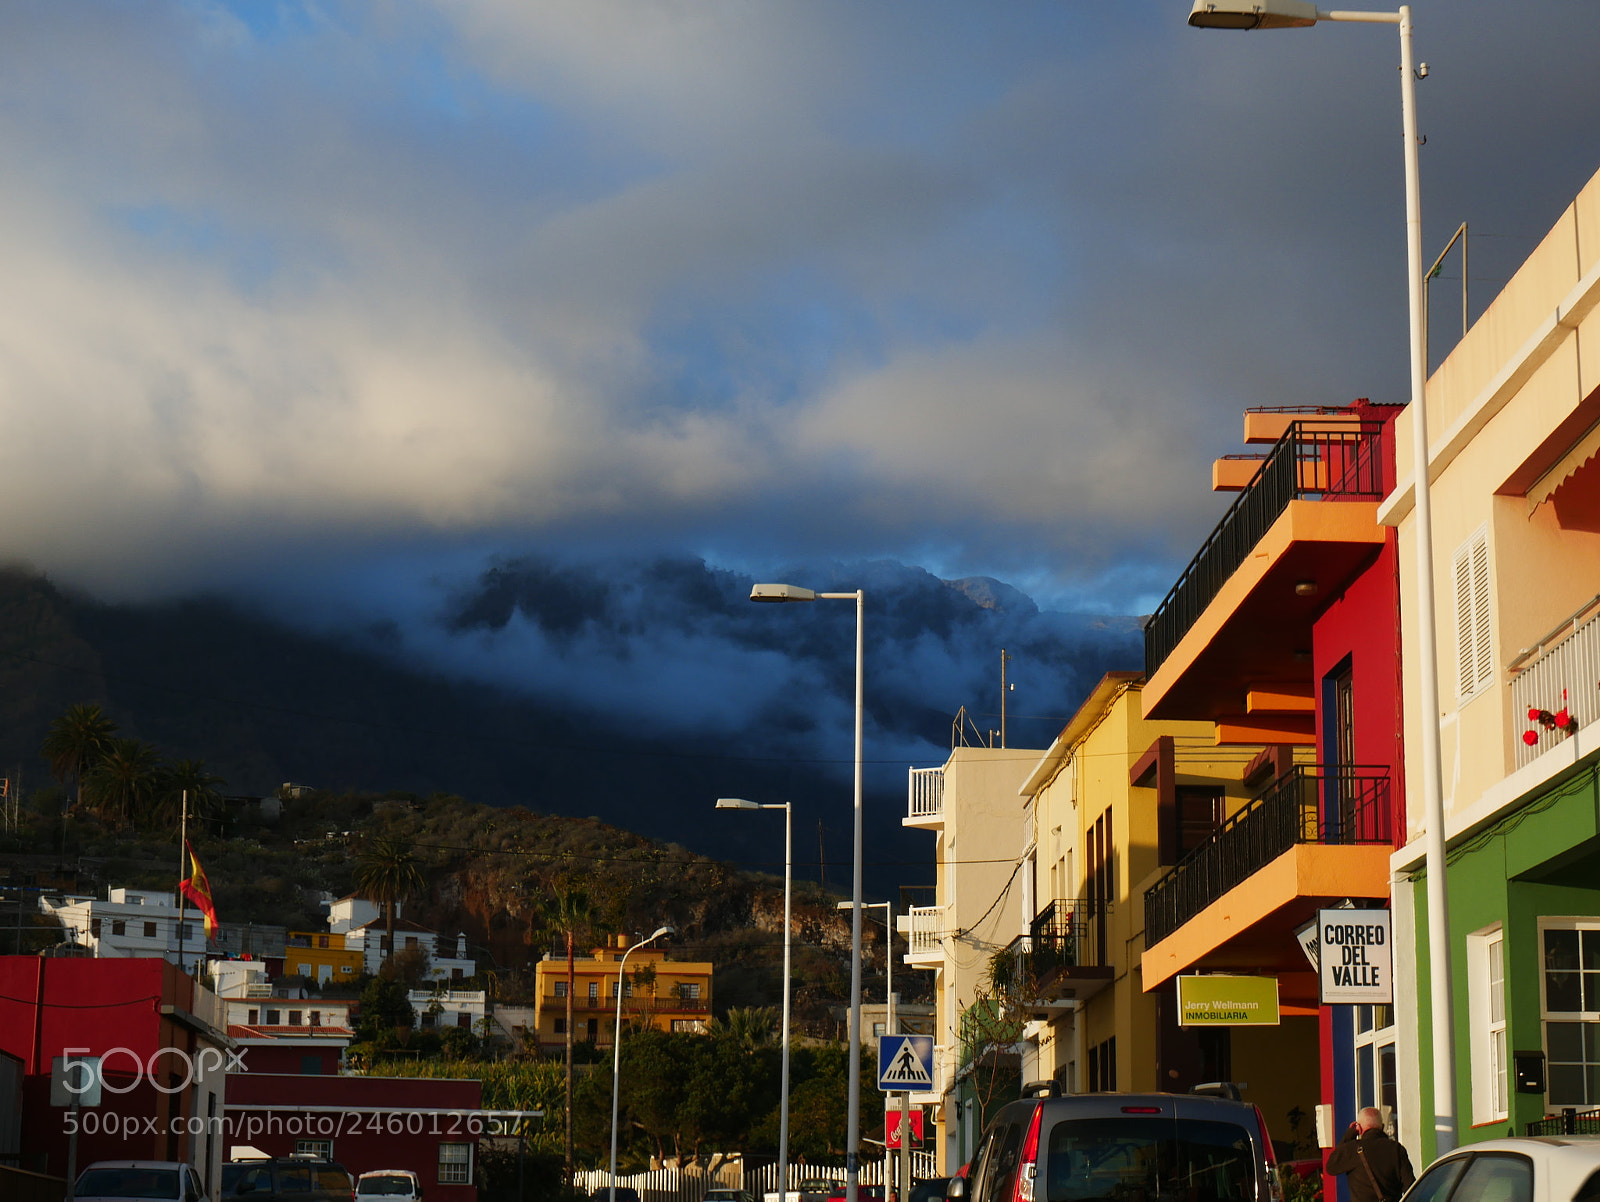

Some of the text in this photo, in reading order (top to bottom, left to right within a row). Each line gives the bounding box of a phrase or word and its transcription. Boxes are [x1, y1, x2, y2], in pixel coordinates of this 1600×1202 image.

[1325, 925, 1384, 945] CORREO
[1342, 946, 1370, 965] DEL
[1332, 966, 1380, 986] VALLE
[1185, 1001, 1259, 1011] Jerry Wellmann
[1186, 1012, 1248, 1020] INMOBILIARIA
